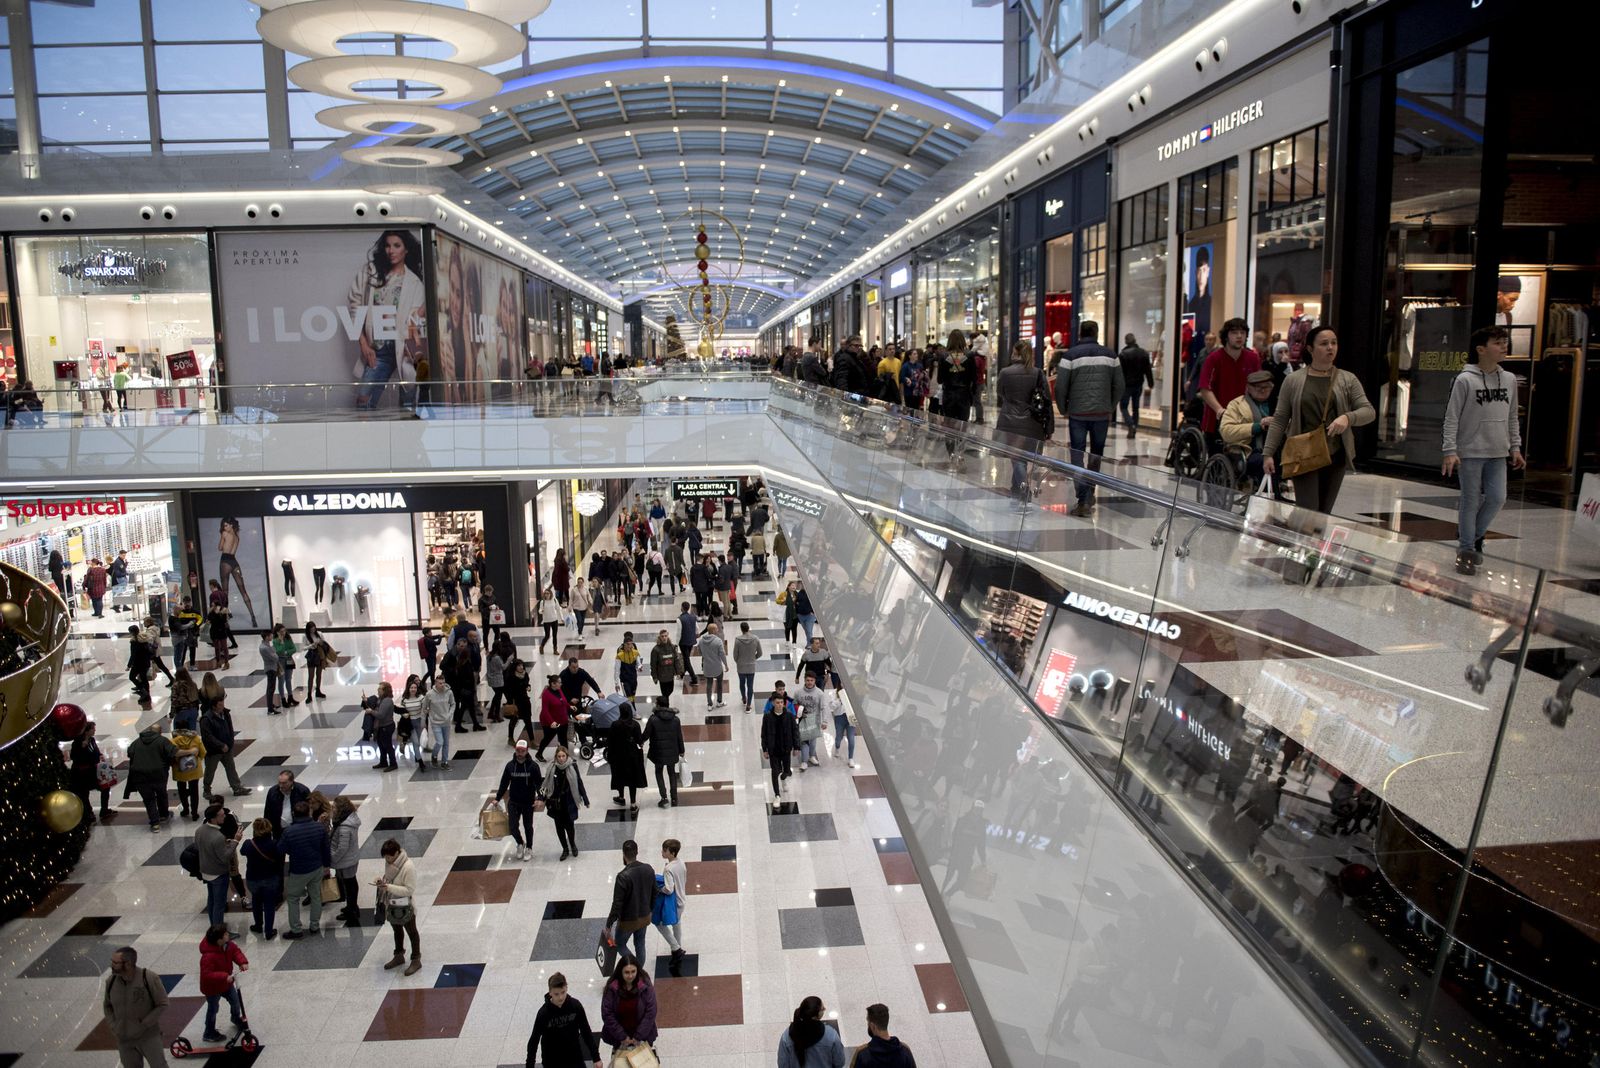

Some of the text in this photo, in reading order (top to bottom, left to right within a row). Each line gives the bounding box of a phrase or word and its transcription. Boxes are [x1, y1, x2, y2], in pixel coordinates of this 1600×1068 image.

[1157, 99, 1264, 161] TOMMY HILFIGER
[84, 266, 135, 276] SWAROVSKI
[233, 257, 299, 266] APERTURA
[246, 305, 398, 343] I LOVE
[173, 359, 194, 372] 50%
[1419, 351, 1469, 371] REBAJAS
[1476, 388, 1510, 406] SAVAGE
[6, 496, 128, 521] Soloptical
[272, 491, 407, 512] CALZEDONIA
